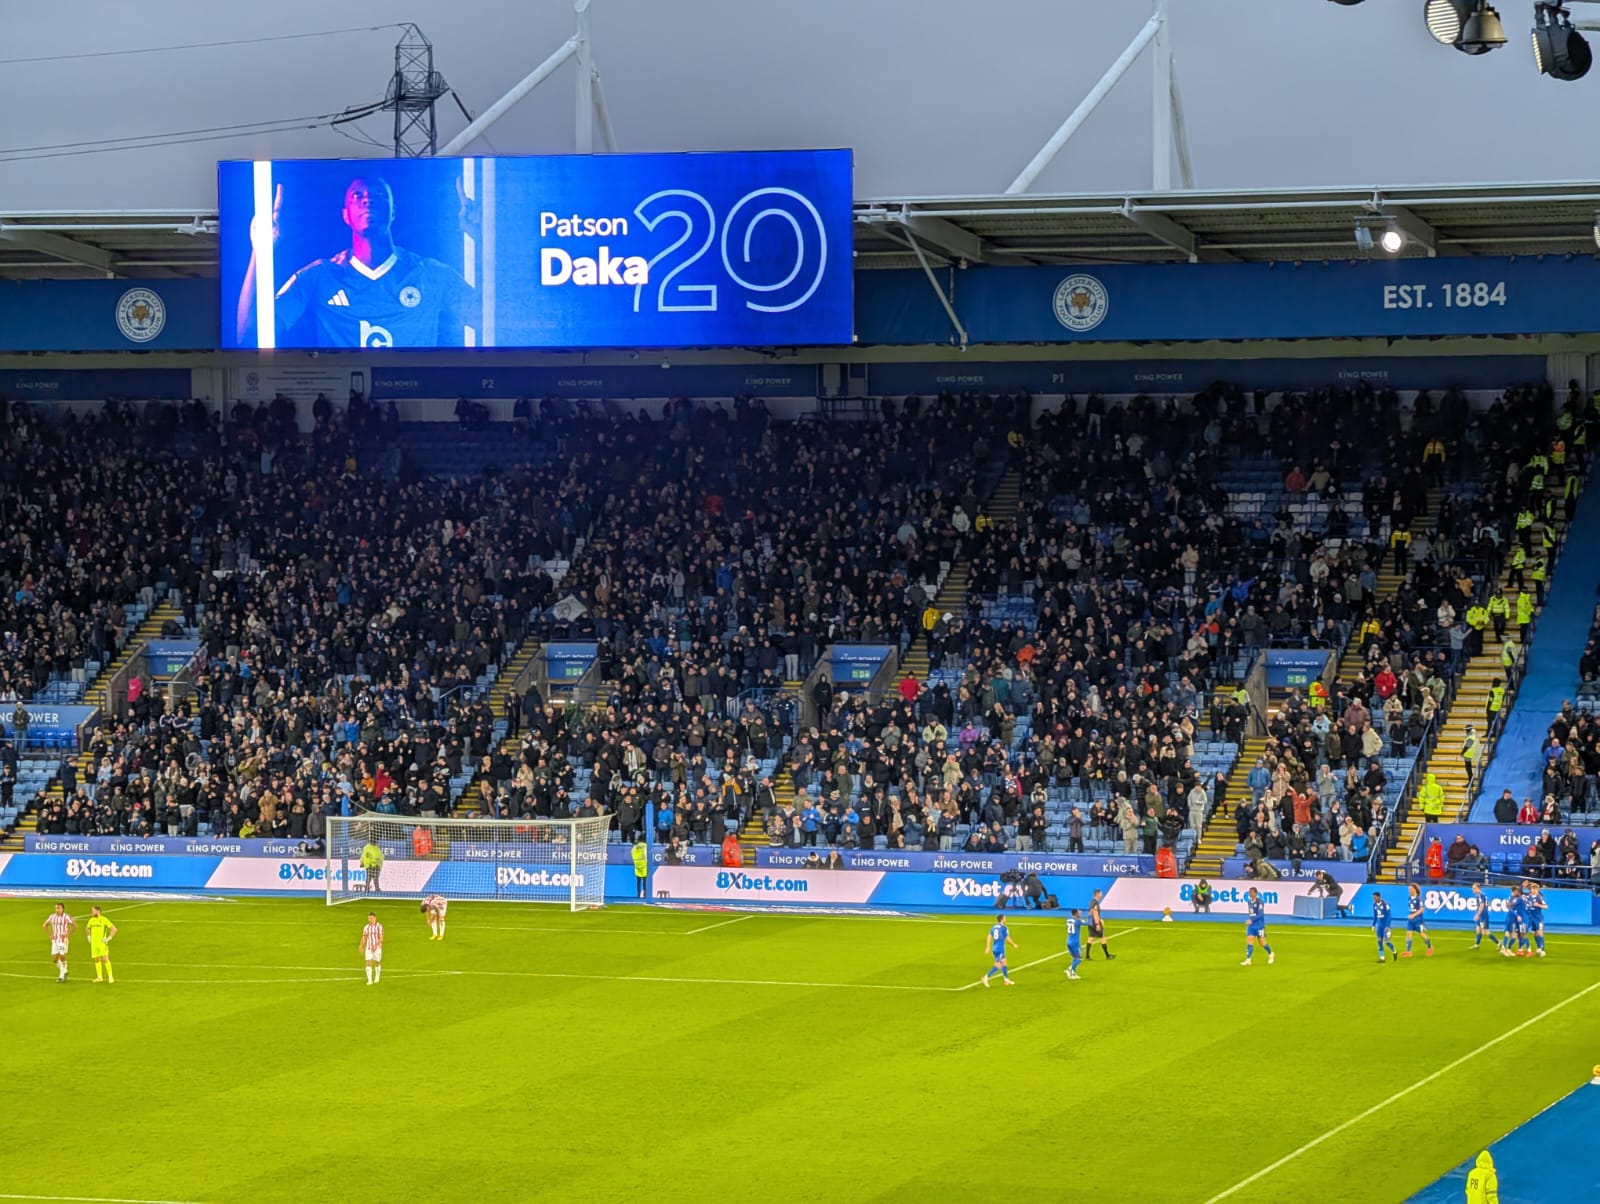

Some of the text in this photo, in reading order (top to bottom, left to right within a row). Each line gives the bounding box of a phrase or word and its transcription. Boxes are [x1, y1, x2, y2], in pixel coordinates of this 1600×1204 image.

[540, 211, 627, 237] Patson
[633, 187, 827, 313] 20
[540, 246, 649, 286] Daka
[1384, 281, 1507, 309] EST. 1884
[1052, 373, 1064, 384] P1
[482, 379, 495, 389] P2
[1500, 835, 1531, 846] KING
[36, 842, 89, 850] KING POWER
[112, 843, 165, 852] KING POWER
[187, 844, 241, 853] KING POWER
[263, 845, 285, 854] KING
[465, 850, 488, 858] KING
[577, 852, 608, 860] POWER
[770, 856, 794, 864] KING
[852, 858, 911, 868] KING POWER
[66, 858, 153, 880] 8Xbet.com
[934, 861, 993, 870] KING POWER
[1018, 862, 1078, 872] KING POWER
[1103, 864, 1127, 873] KING
[716, 871, 808, 893] 8Xbet.com
